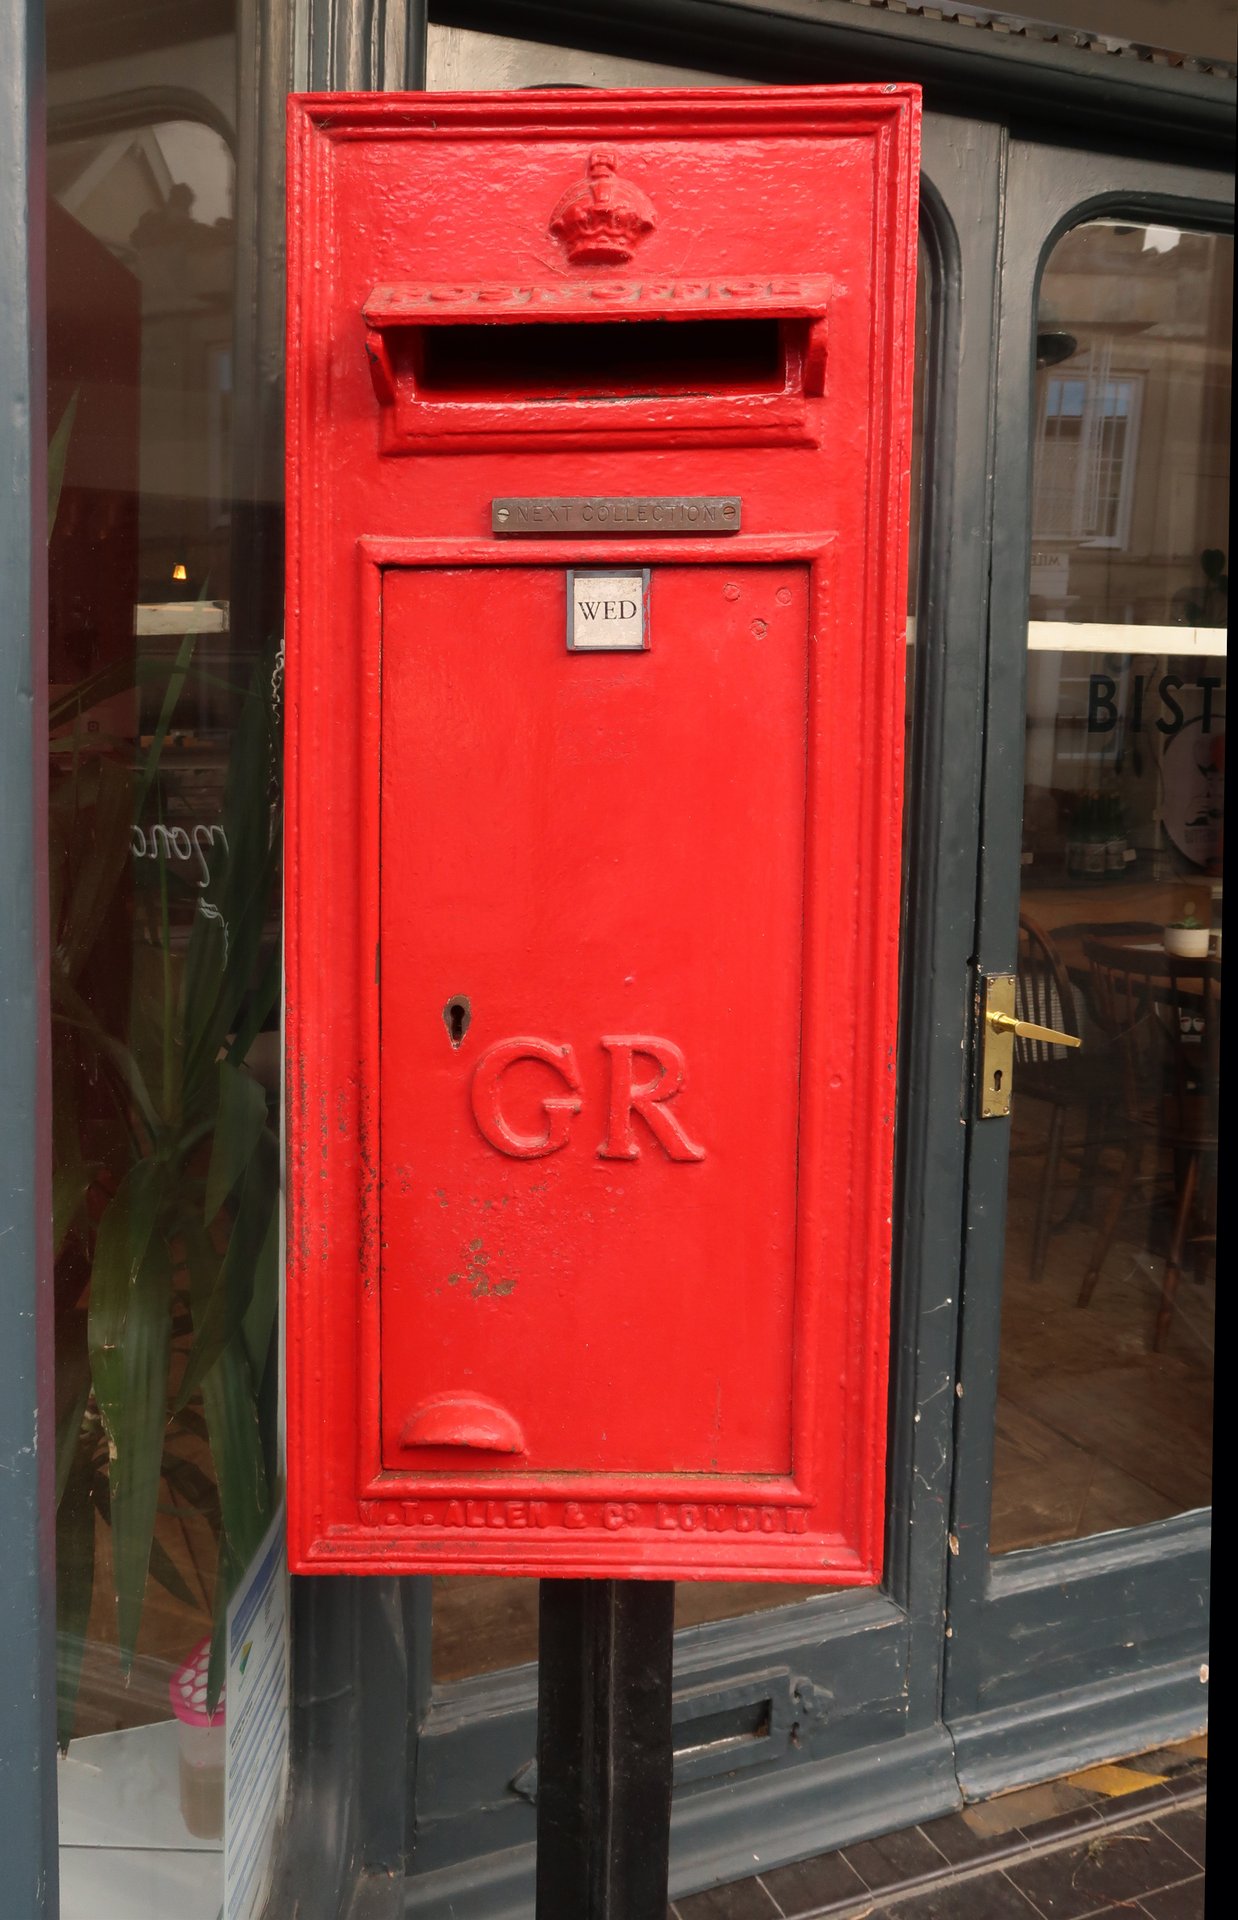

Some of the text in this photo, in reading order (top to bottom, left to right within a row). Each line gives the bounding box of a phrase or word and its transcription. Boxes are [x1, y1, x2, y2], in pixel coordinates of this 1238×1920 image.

[516, 504, 717, 523] NEXT COLLECTION
[578, 600, 638, 621] WED
[1087, 673, 1222, 735] BIST
[470, 1034, 706, 1161] GR
[442, 1500, 549, 1529] ALLEN
[562, 1501, 588, 1530] &
[656, 1501, 810, 1535] LONDON
